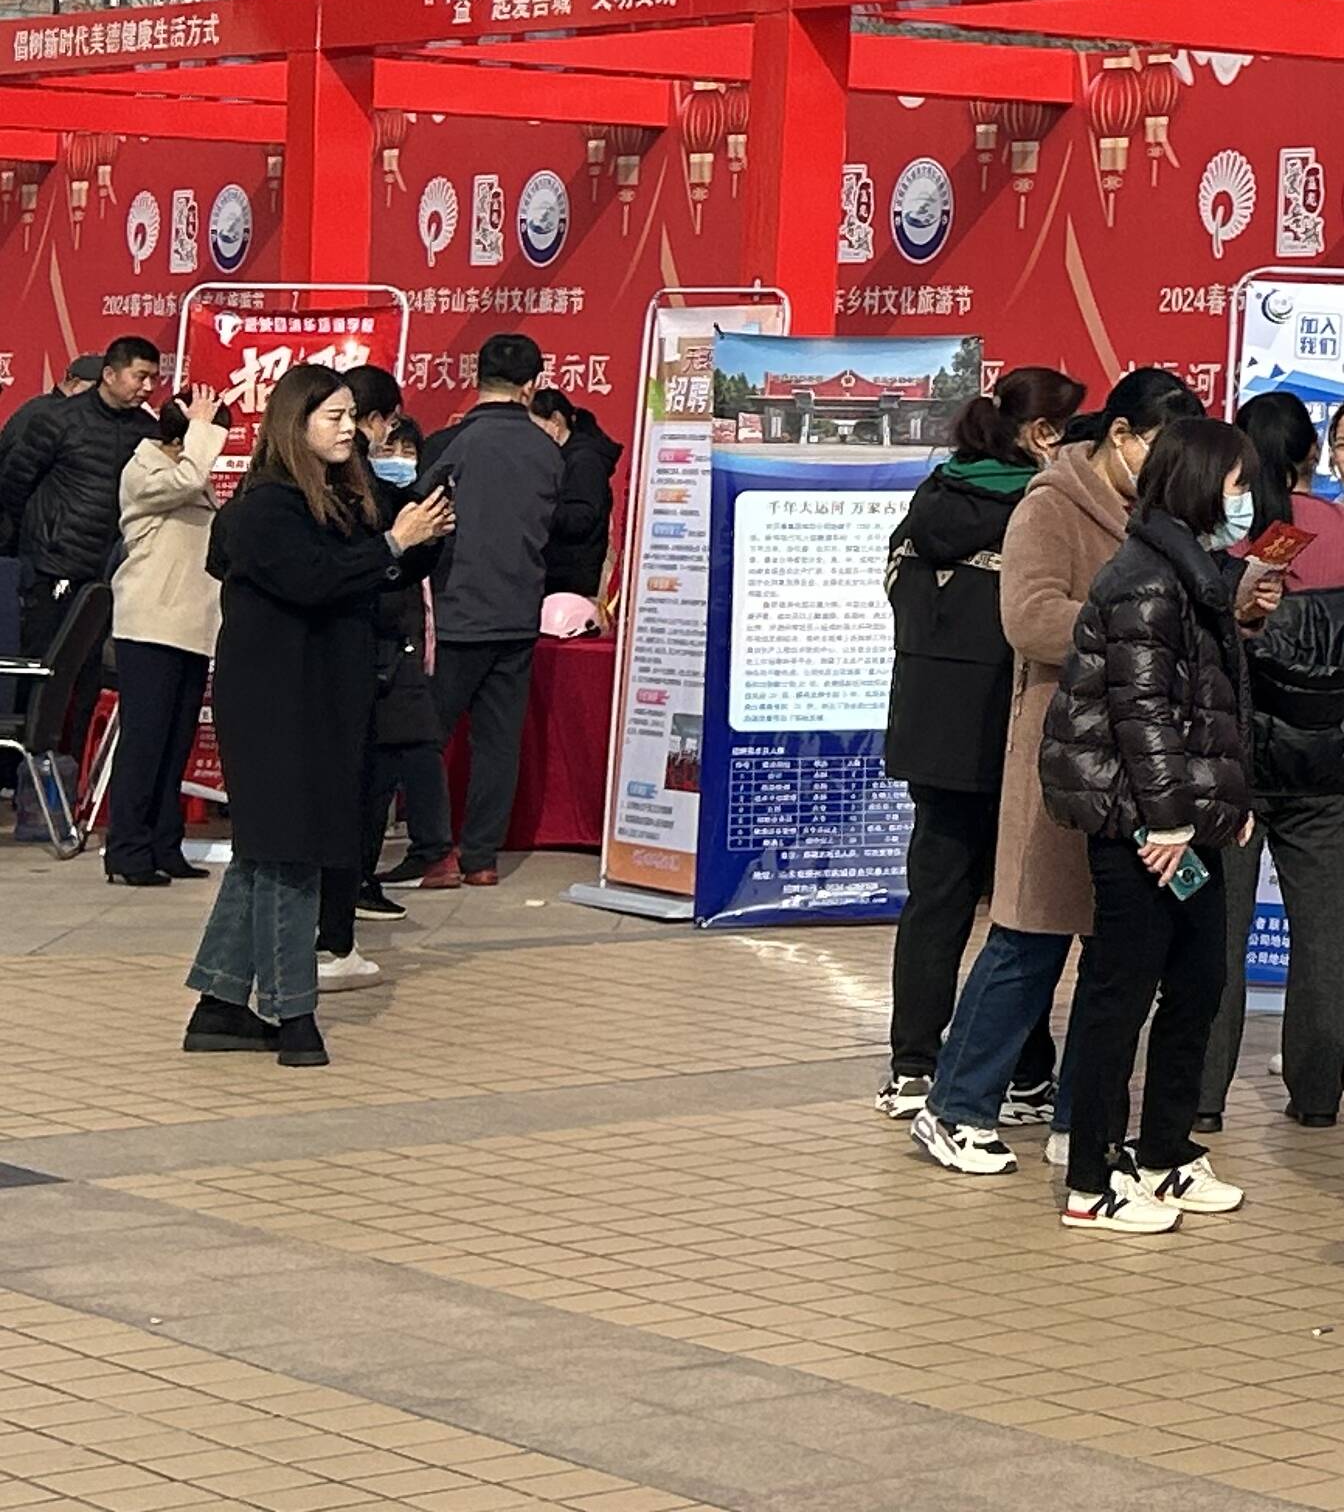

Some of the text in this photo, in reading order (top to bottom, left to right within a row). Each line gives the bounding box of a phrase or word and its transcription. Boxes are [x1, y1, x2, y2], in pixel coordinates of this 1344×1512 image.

[13, 13, 220, 61] 倡树新时代美德健康生活方式
[1300, 316, 1336, 334] 加入
